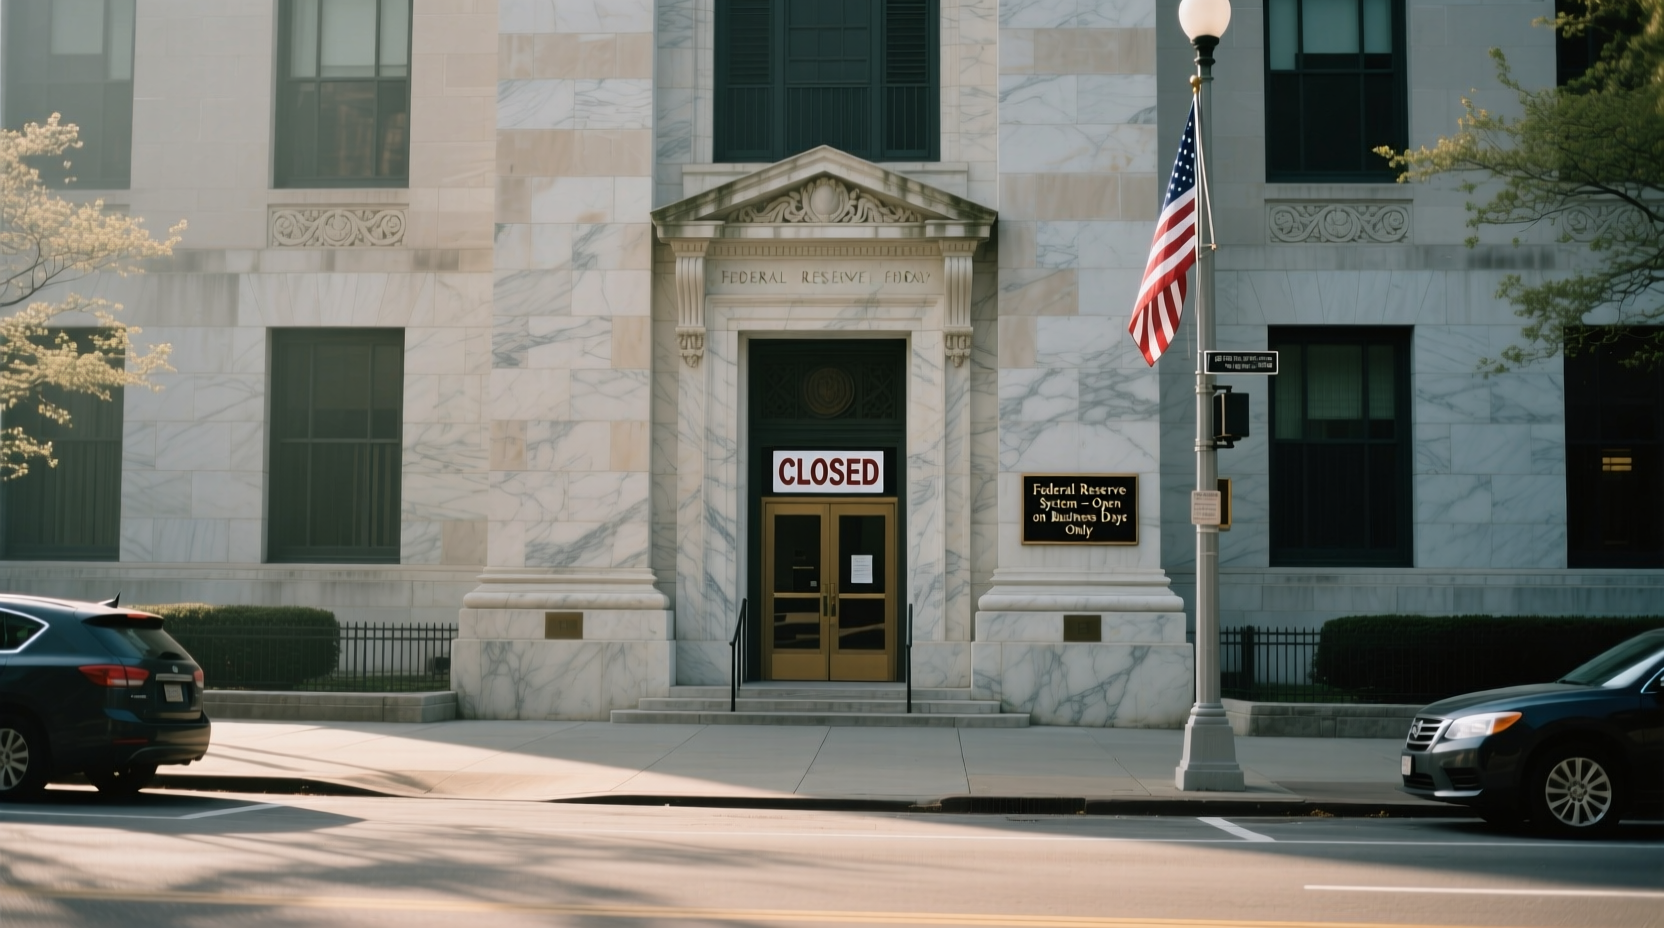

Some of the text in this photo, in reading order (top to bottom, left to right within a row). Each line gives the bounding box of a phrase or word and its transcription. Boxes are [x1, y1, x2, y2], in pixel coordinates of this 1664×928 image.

[721, 270, 787, 284] FEDERAL
[778, 457, 880, 486] CLOSED
[1033, 482, 1127, 495] Federal Reserve
[1033, 513, 1046, 522] on
[1065, 524, 1093, 539] Only
